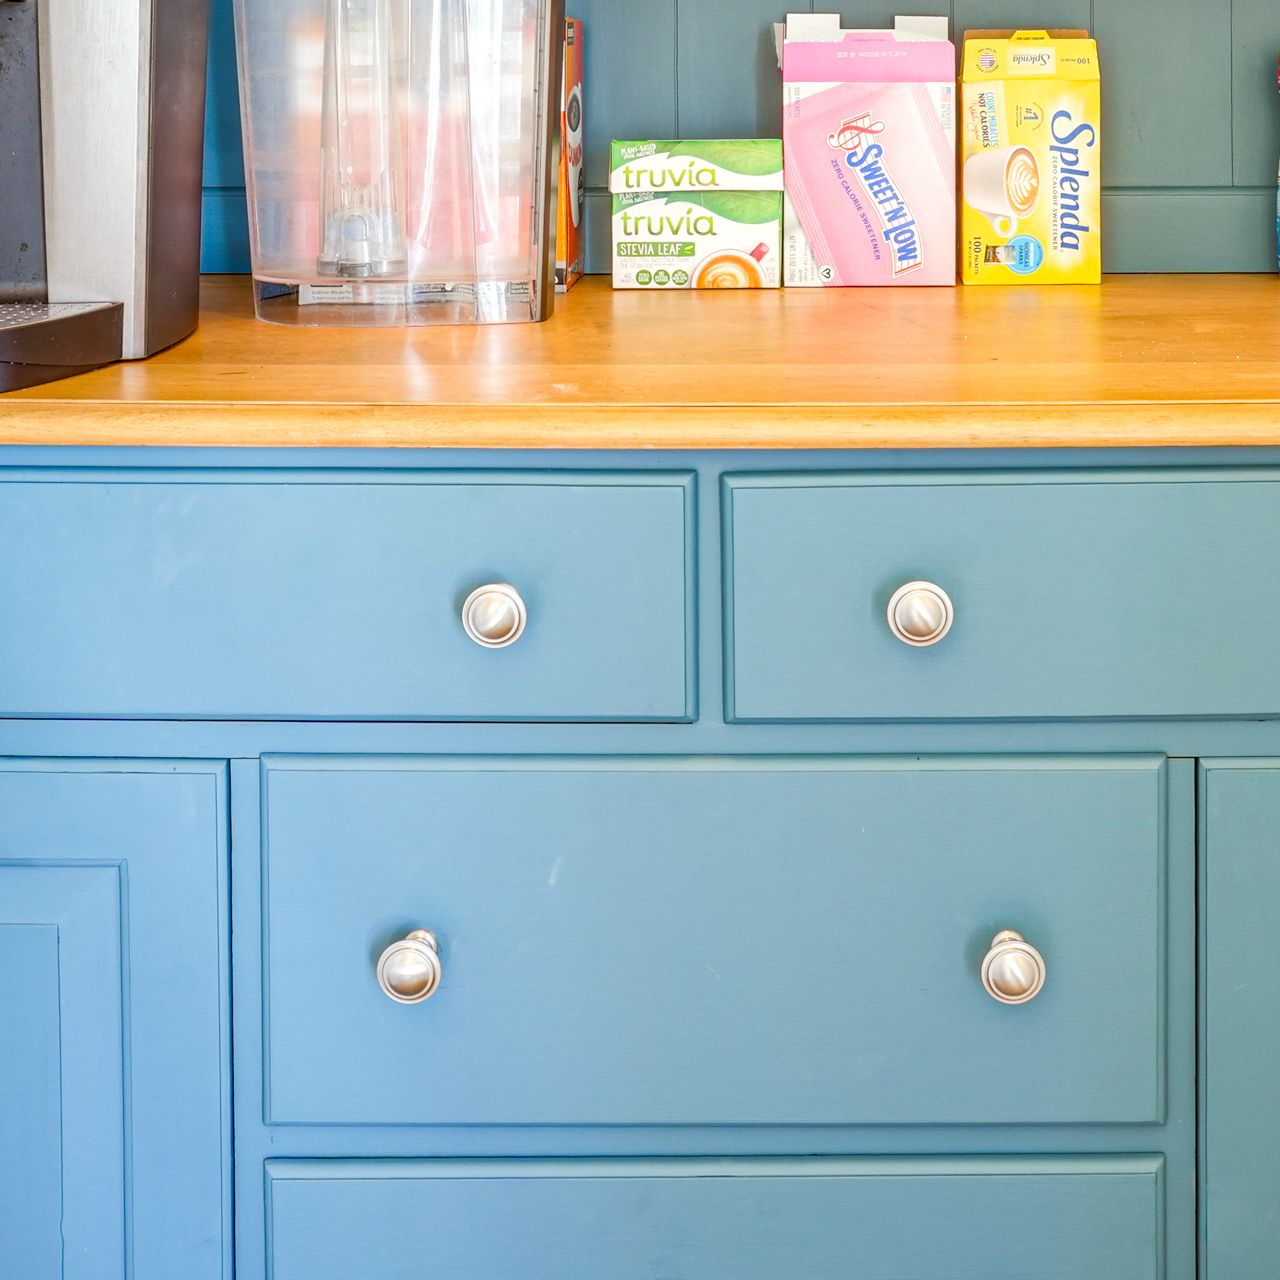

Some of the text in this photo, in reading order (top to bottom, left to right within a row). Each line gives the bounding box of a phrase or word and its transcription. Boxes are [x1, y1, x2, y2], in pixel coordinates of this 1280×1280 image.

[1012, 53, 1051, 66] Splenda
[978, 93, 990, 148] NOT CALORIES
[1023, 107, 1039, 121] #1
[1049, 109, 1095, 251] Splenda
[831, 159, 881, 261] ZERO CALORIE SWEETENER
[620, 243, 683, 256] STEVIA LEAF
[883, 219, 918, 262] LOW
[973, 236, 982, 253] 100
